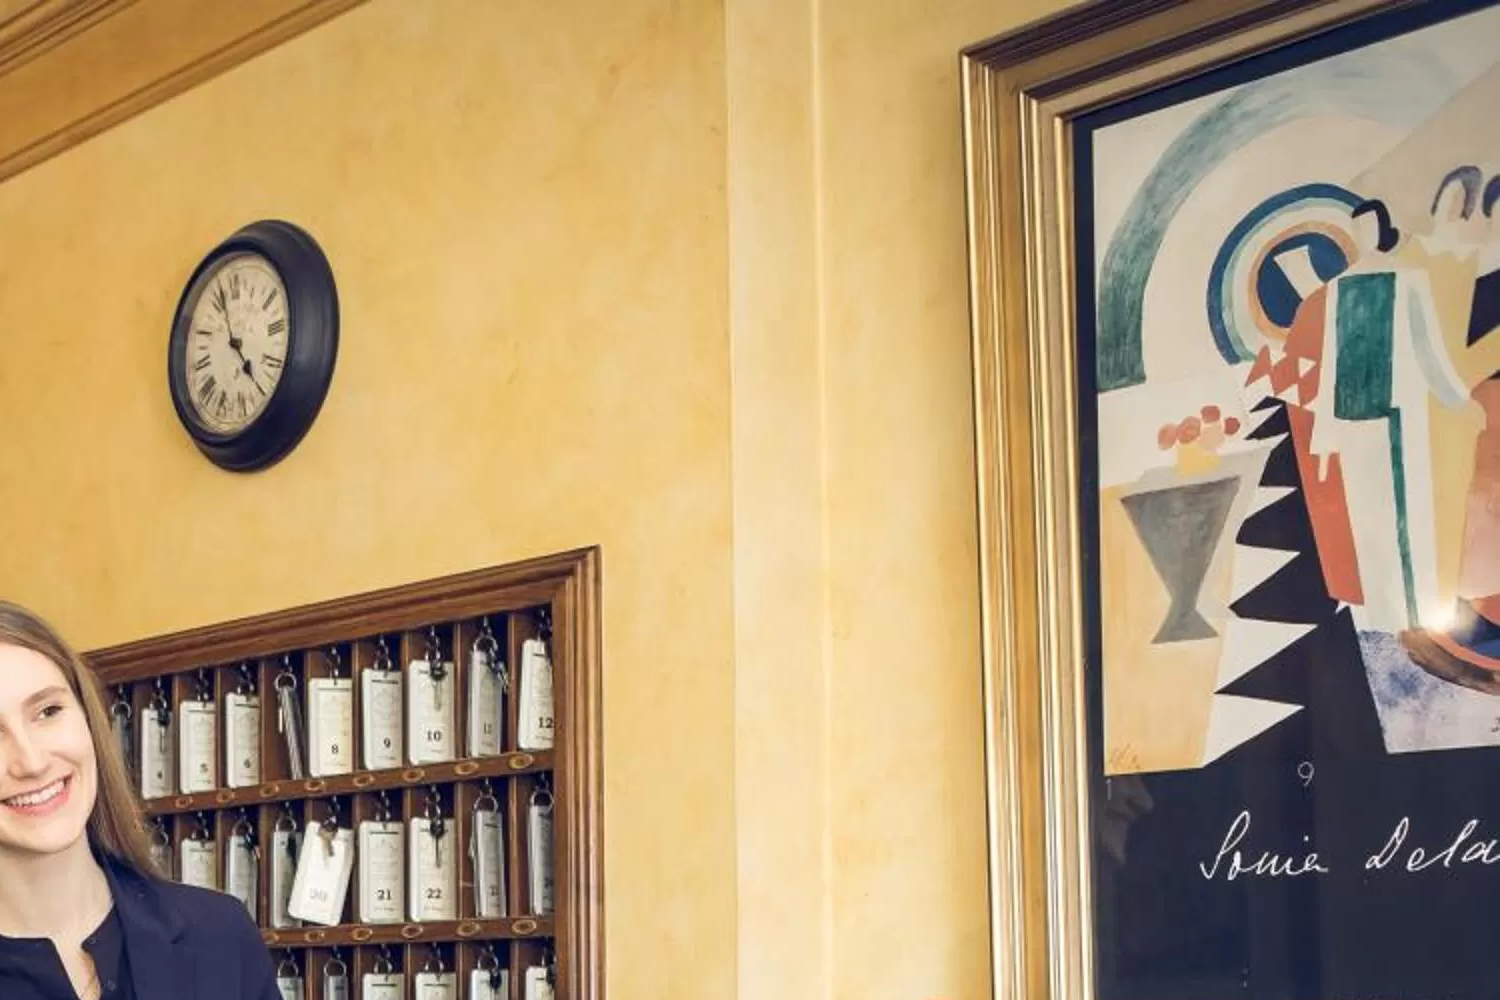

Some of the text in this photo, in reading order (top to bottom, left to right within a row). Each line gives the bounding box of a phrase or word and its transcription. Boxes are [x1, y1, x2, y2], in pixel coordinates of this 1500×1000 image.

[537, 715, 555, 729] 12
[426, 730, 443, 742] 10
[331, 743, 339, 755] 8
[383, 737, 392, 749] 9
[376, 888, 393, 901] 21
[426, 887, 443, 900] 22
